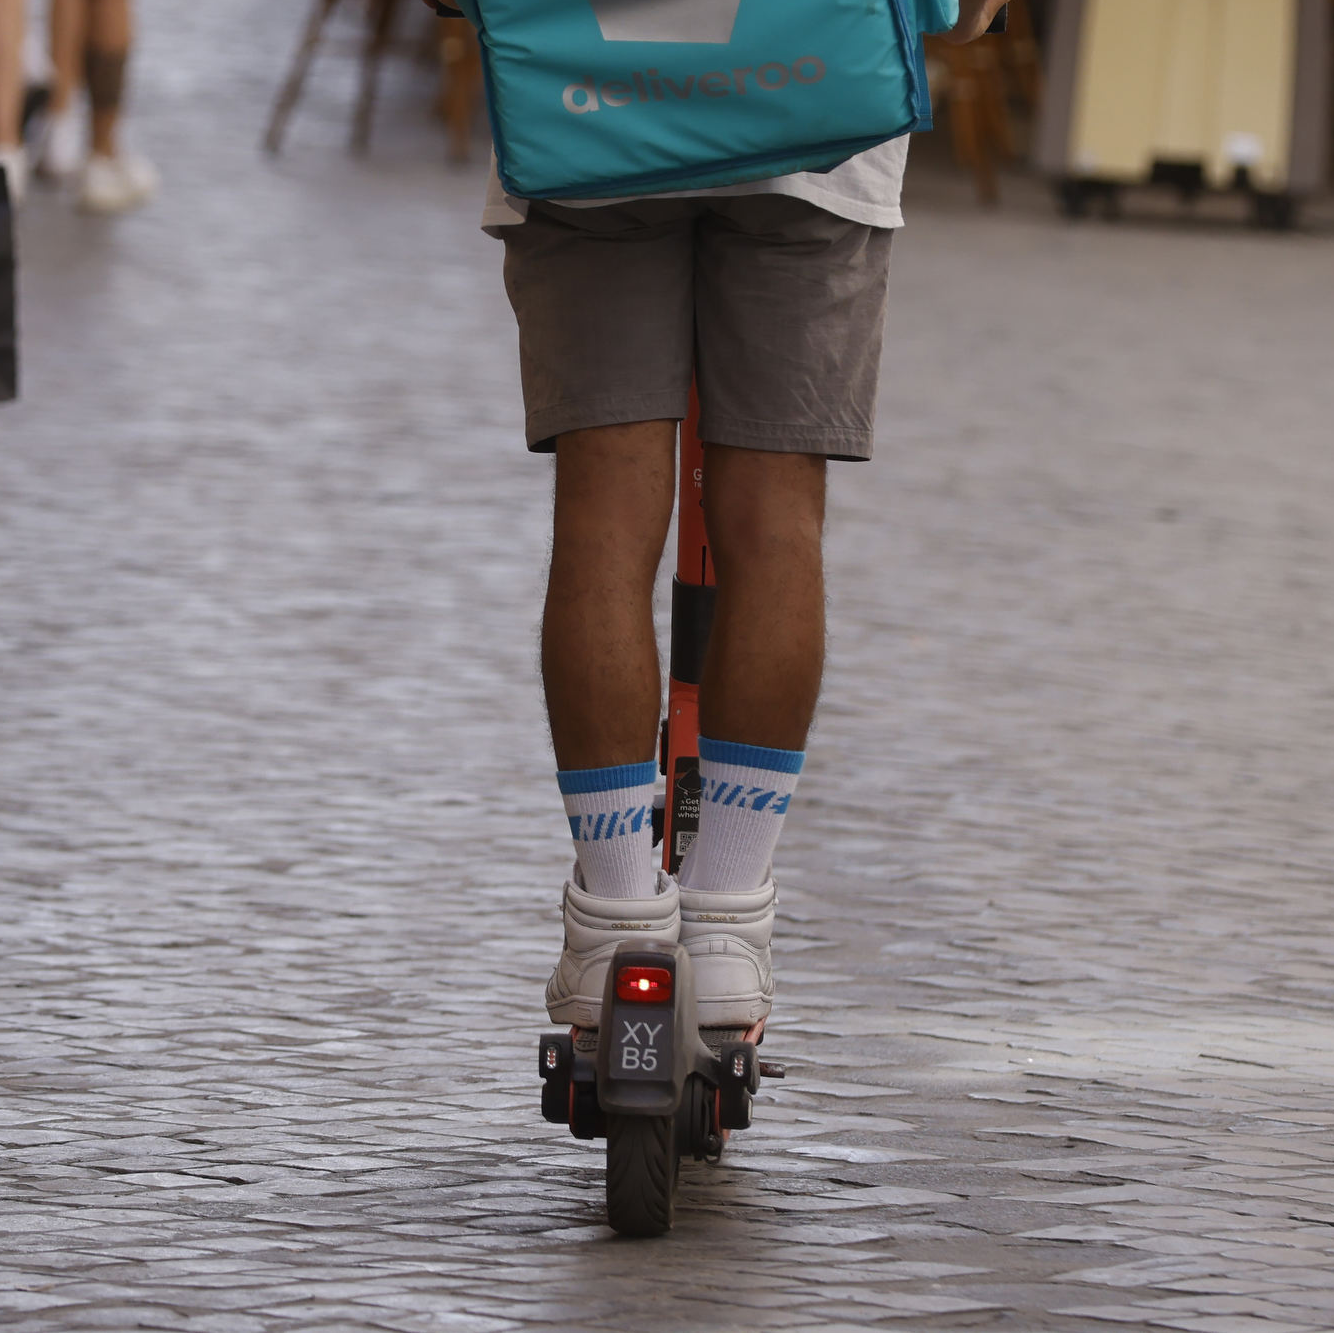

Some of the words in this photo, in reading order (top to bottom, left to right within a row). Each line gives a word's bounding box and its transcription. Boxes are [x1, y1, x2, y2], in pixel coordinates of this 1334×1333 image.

[562, 55, 827, 114] deliveroo
[680, 804, 700, 813] magi
[701, 776, 792, 815] NIKE
[570, 805, 653, 841] NIKE
[620, 1020, 664, 1046] XY
[621, 1046, 658, 1071] B5
